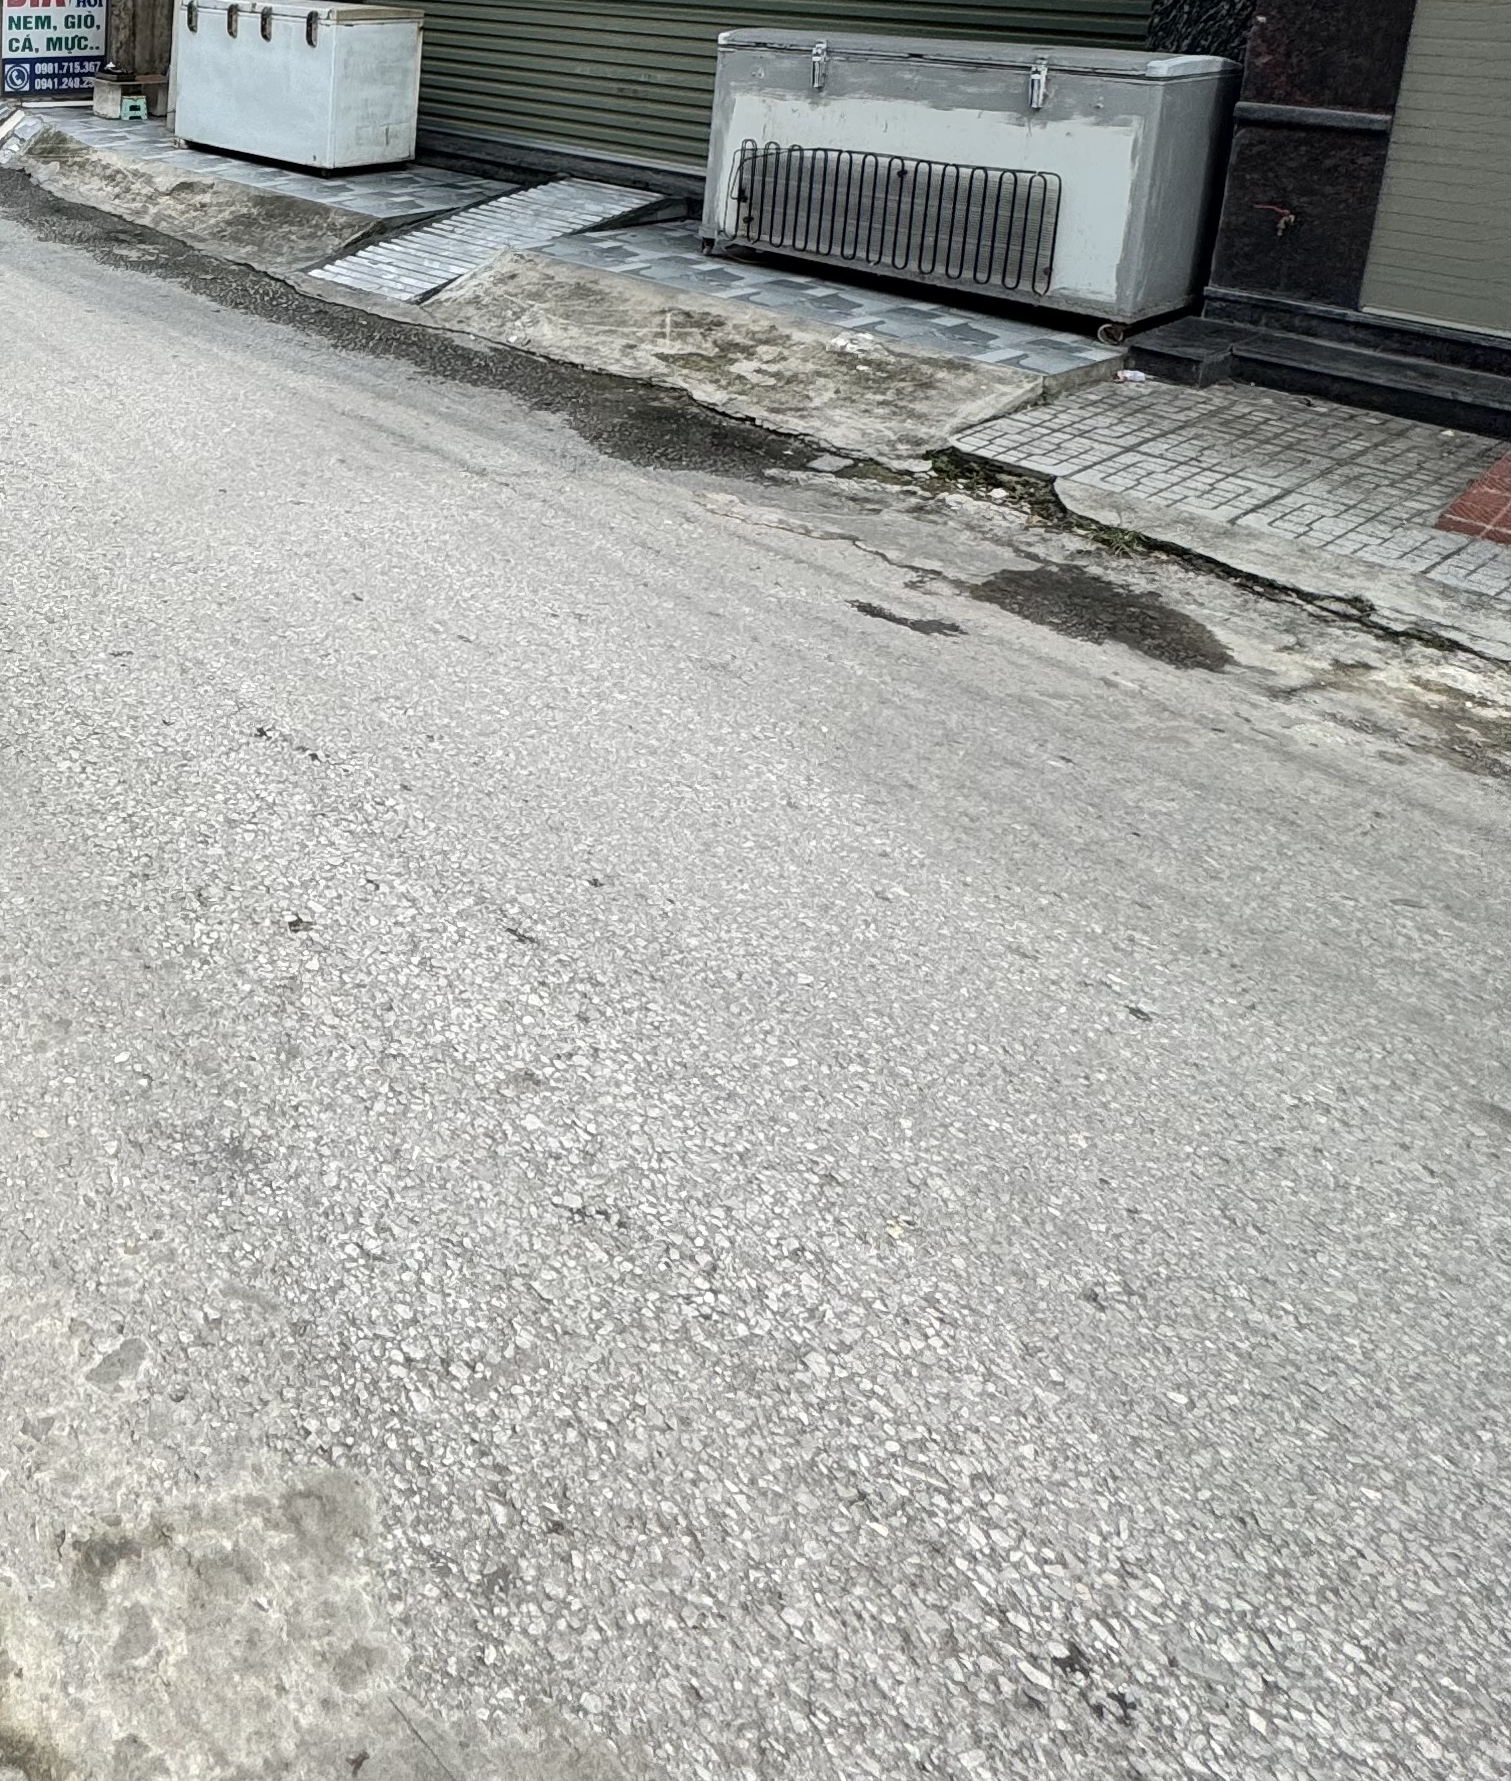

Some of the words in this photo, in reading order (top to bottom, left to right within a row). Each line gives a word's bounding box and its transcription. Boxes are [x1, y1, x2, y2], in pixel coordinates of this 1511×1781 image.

[8, 15, 57, 31] NEM,
[64, 11, 101, 31] GIÒ,
[8, 34, 39, 53] CÁ,
[46, 35, 100, 54] MỰC..
[35, 61, 101, 74] 0981.715.367
